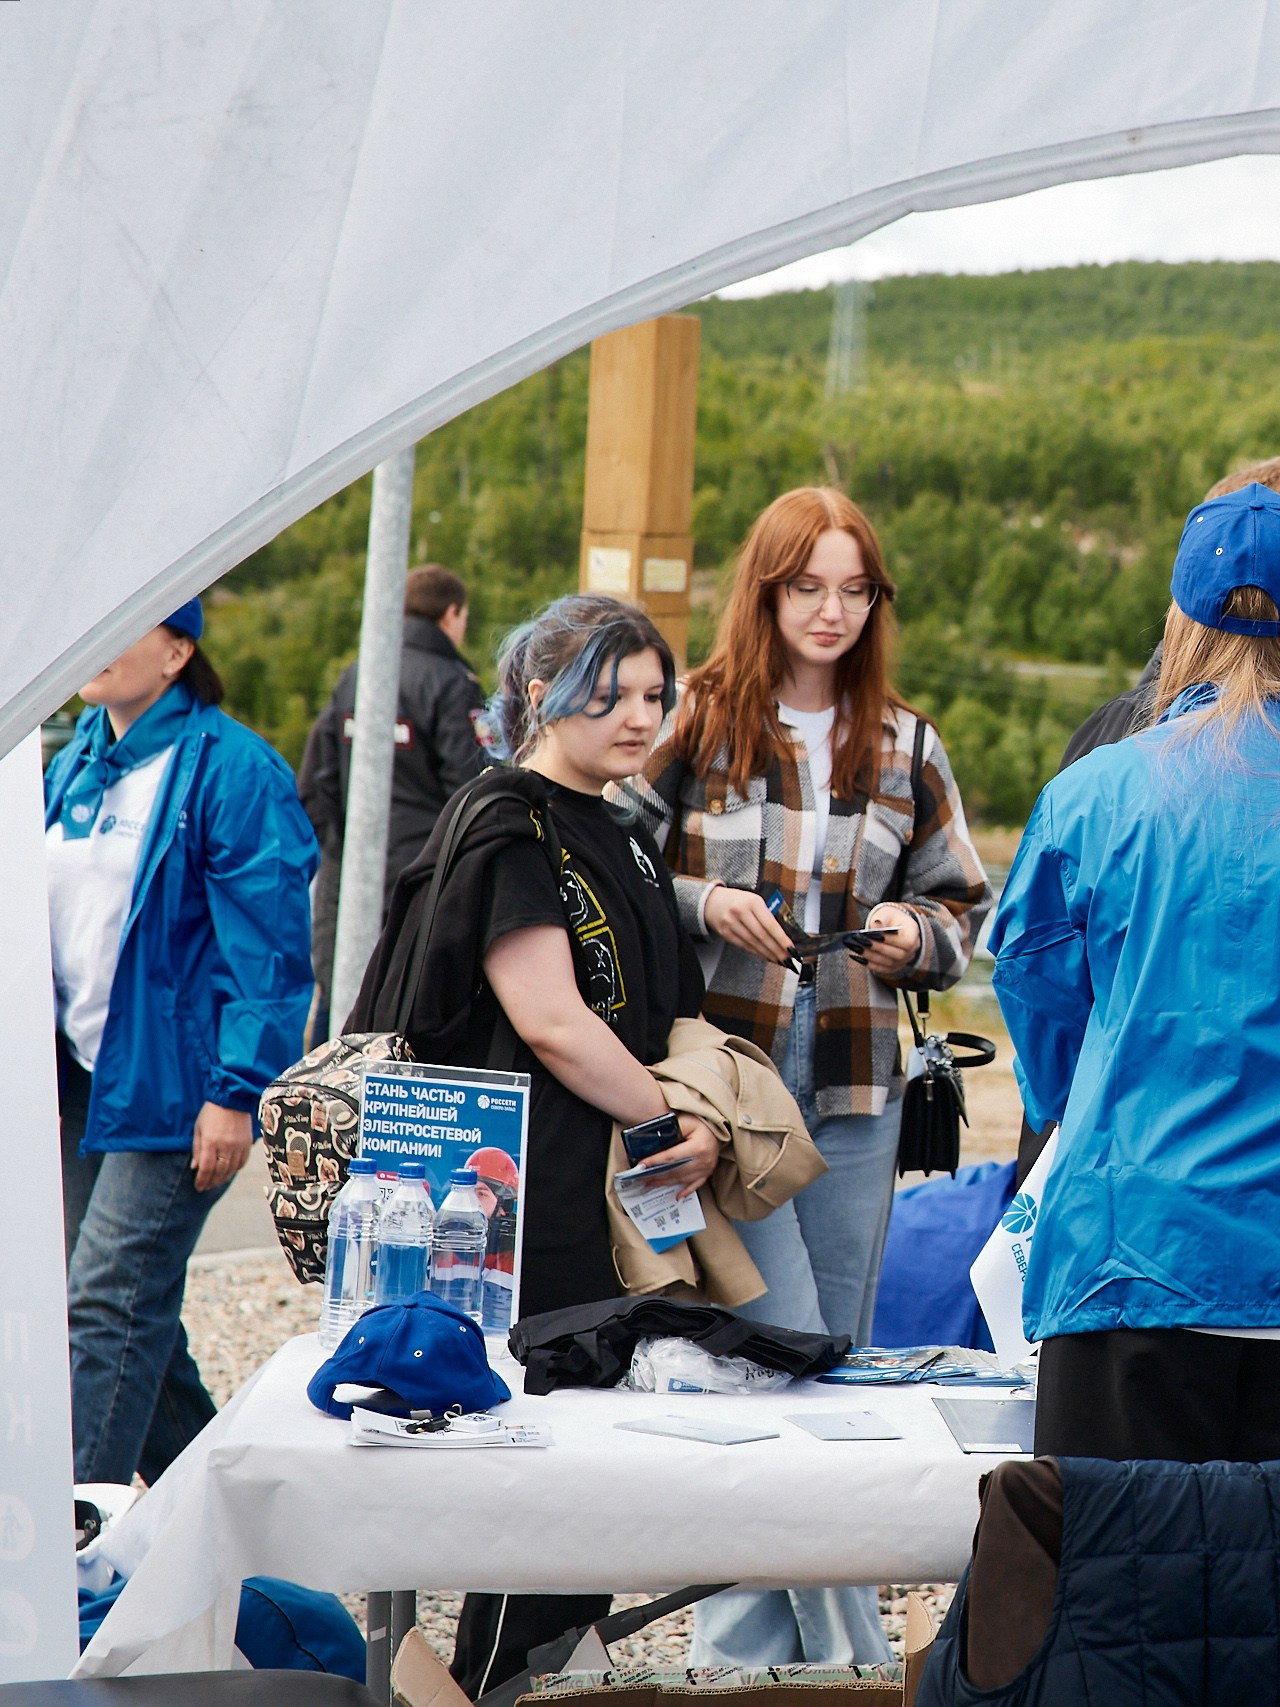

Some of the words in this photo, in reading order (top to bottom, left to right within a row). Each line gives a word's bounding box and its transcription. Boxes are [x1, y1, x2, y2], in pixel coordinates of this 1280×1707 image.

[365, 1082, 409, 1098] СТАНЬ
[411, 1087, 466, 1105] ЧАСТЬЮ
[490, 1097, 517, 1106] РОССЕТИ
[364, 1100, 458, 1122] КРУПНЕЙШЕЙ
[363, 1119, 482, 1143] ЭЛЕКТРОСЕТЕВОЙ
[363, 1137, 442, 1158] КОМПАНИИ!
